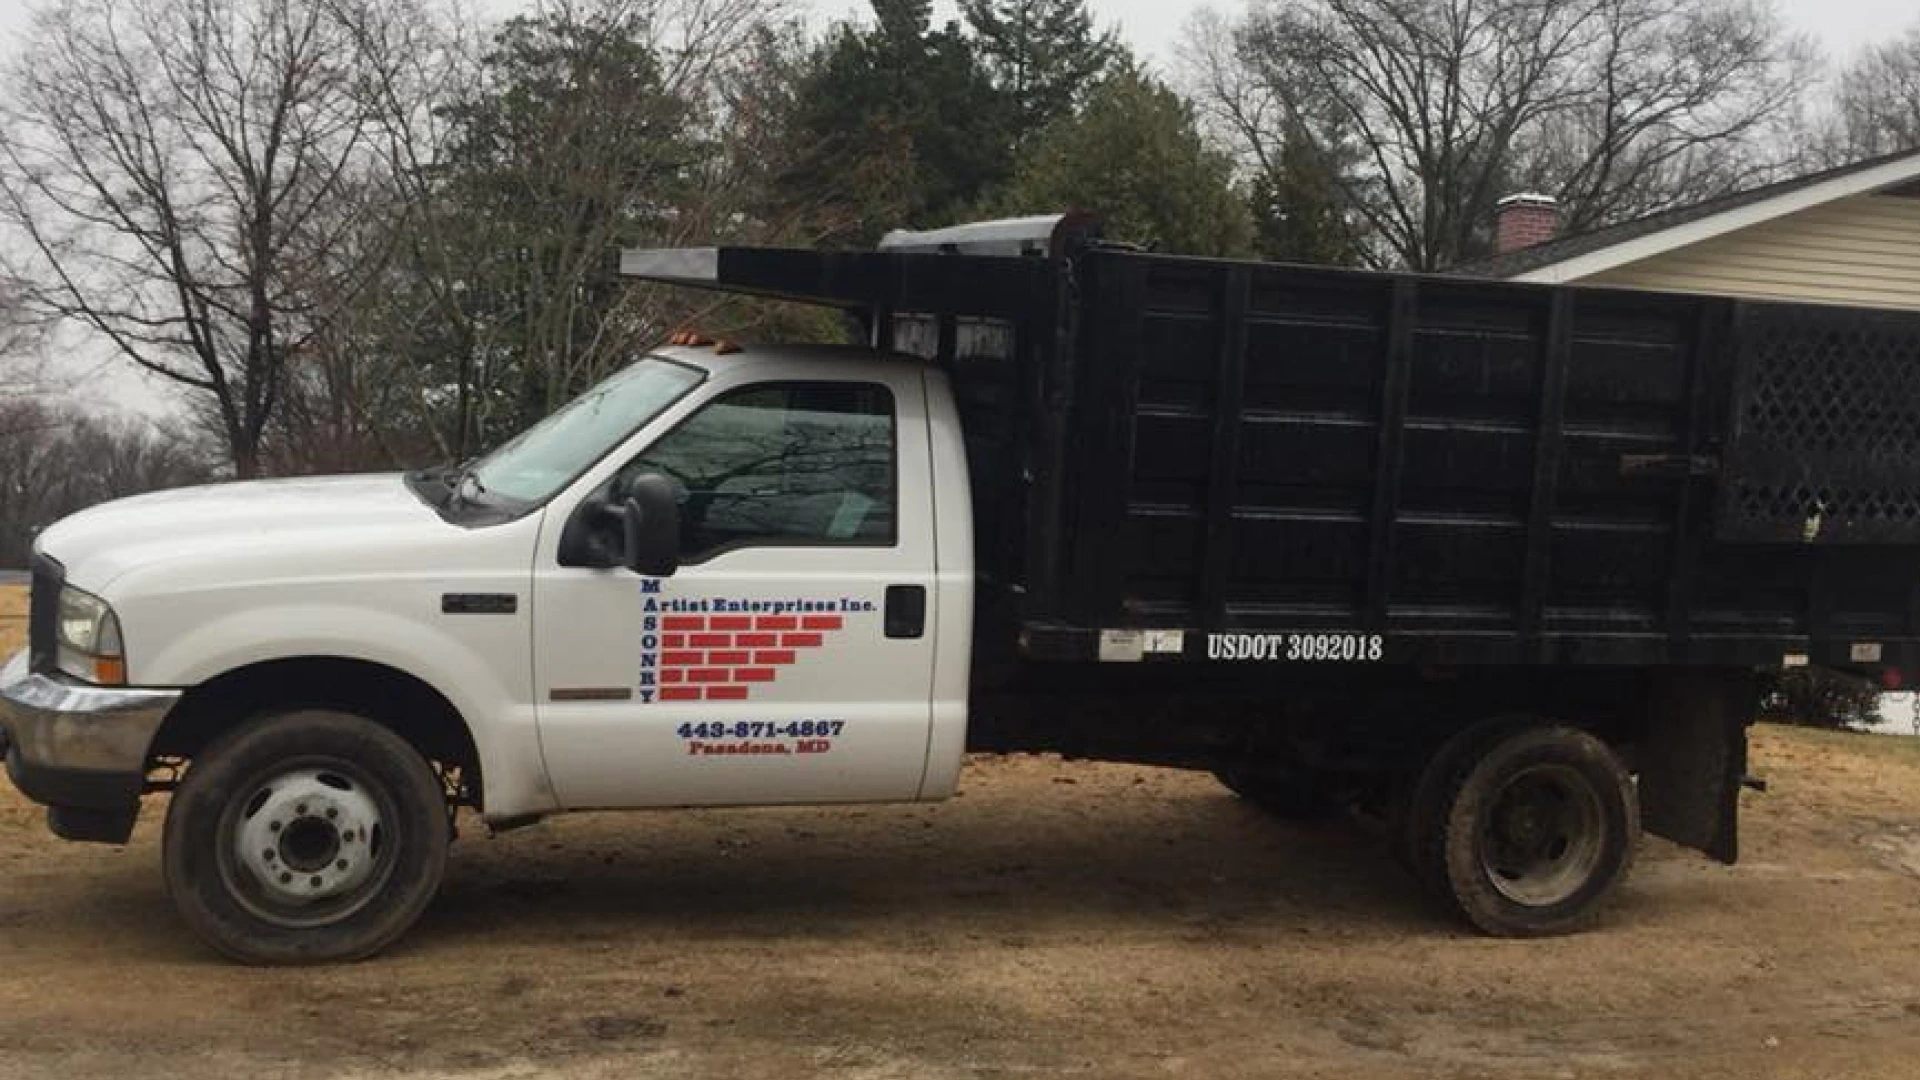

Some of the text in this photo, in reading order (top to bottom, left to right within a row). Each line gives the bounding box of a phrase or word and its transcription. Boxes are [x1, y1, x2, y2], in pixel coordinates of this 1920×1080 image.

[713, 599, 836, 615] Enterprises
[839, 599, 878, 612] Inc.
[640, 579, 660, 703] MASONRY
[1207, 634, 1383, 661] USDOT 3092018
[677, 720, 845, 738] 443-871-4867
[688, 739, 831, 755] Pasadena, MD
